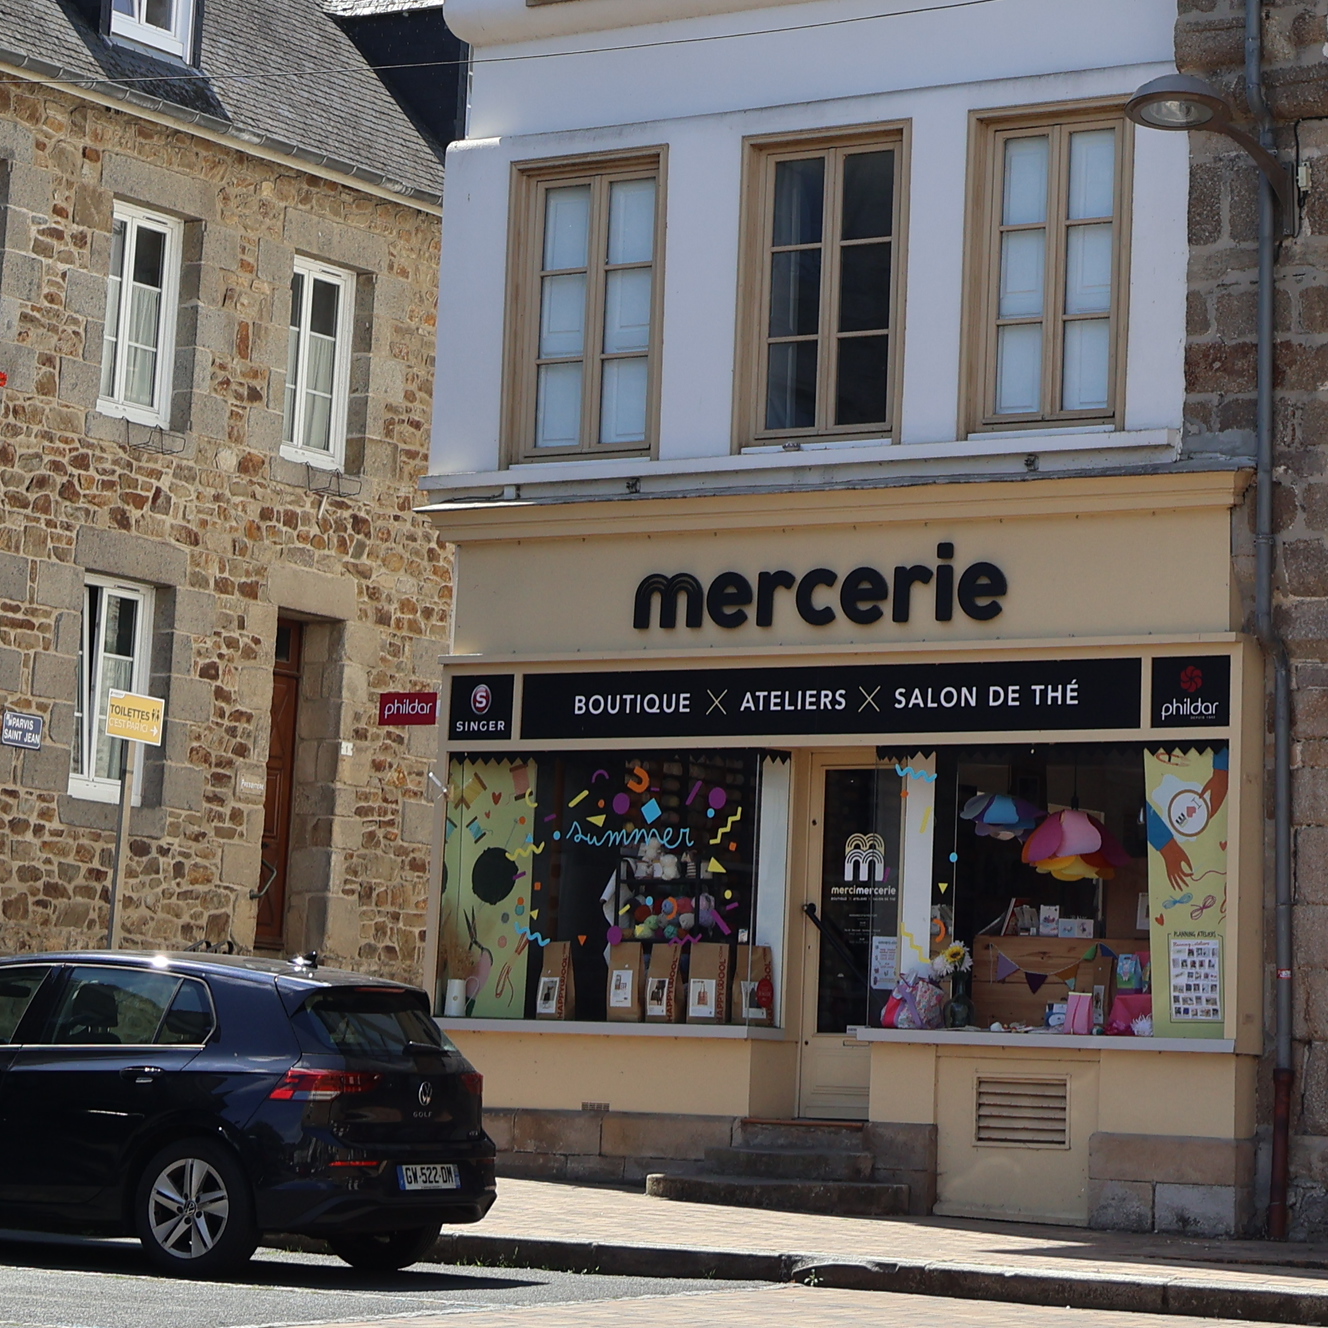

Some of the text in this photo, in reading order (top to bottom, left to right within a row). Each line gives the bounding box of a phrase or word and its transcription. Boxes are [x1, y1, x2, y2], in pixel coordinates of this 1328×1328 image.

[633, 542, 1008, 630] mercerie
[574, 692, 691, 715] BOUTIQUE
[740, 689, 847, 712] ATELIERS
[894, 685, 977, 709] SALON
[989, 685, 1020, 707] DE
[1031, 679, 1079, 705] THÉ
[110, 703, 150, 721] TOILETTES
[385, 699, 433, 719] phildar
[1161, 697, 1220, 721] phildar
[12, 717, 34, 731] PARVIS
[126, 720, 139, 731] PAR
[456, 720, 505, 732] SINGER
[3, 728, 40, 744] SAINT JEAN
[566, 821, 694, 849] summer
[830, 885, 897, 895] mercimercerie
